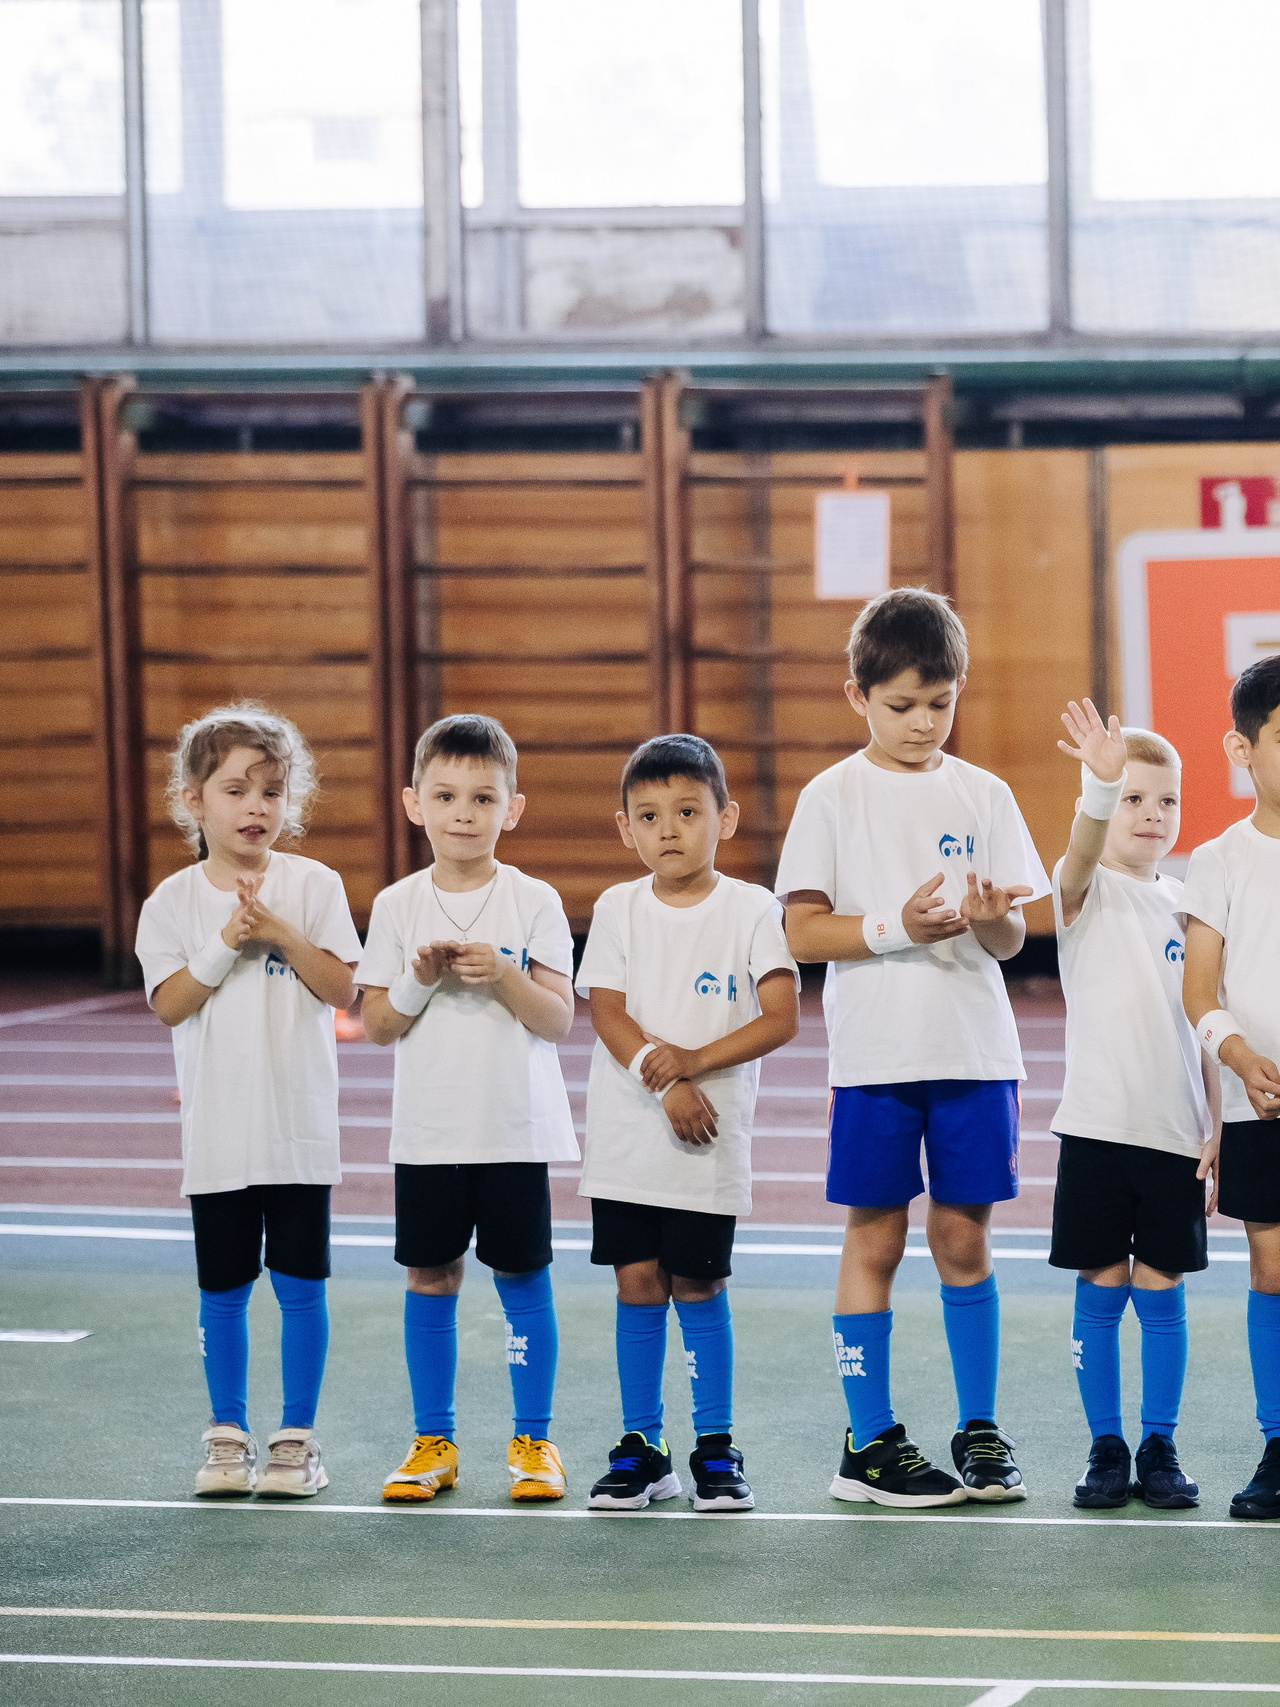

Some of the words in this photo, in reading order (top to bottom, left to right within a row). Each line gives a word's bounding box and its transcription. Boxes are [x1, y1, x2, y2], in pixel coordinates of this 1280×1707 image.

[876, 923, 886, 937] 18
[1204, 1029, 1213, 1042] 18
[506, 1336, 528, 1351] еж
[836, 1346, 865, 1361] еж
[838, 1361, 867, 1377] ик
